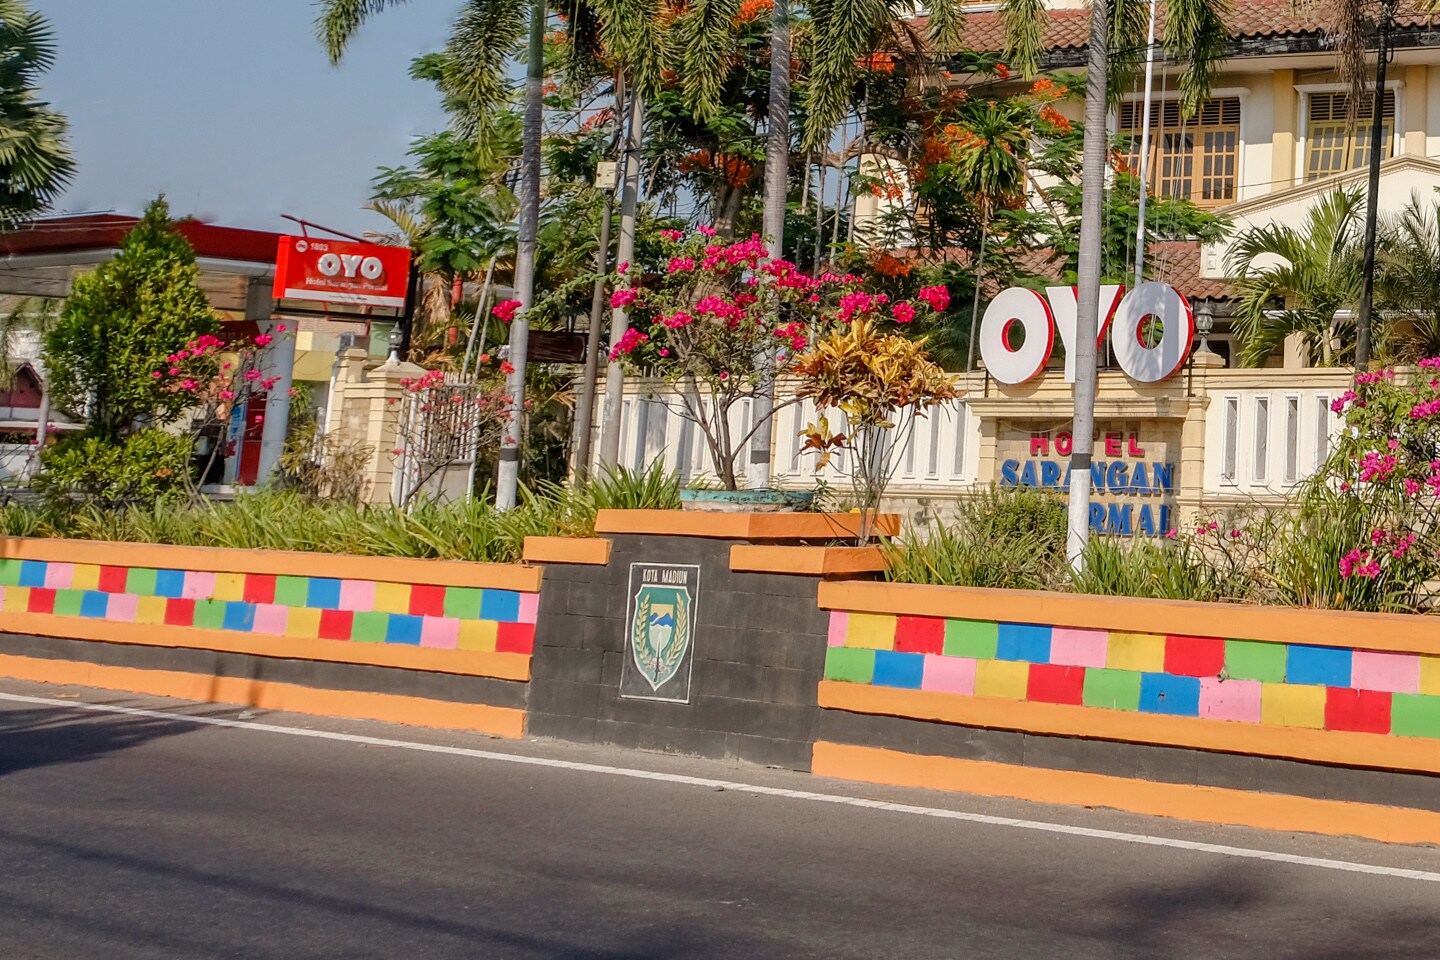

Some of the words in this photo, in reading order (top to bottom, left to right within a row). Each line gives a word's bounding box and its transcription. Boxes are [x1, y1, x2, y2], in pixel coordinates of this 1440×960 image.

[317, 253, 383, 280] OYO
[305, 277, 326, 286] Hotel
[979, 281, 1194, 385] OYO
[1030, 431, 1145, 457] HOEL
[642, 569, 658, 583] KOTA
[662, 569, 688, 584] MADIUN
